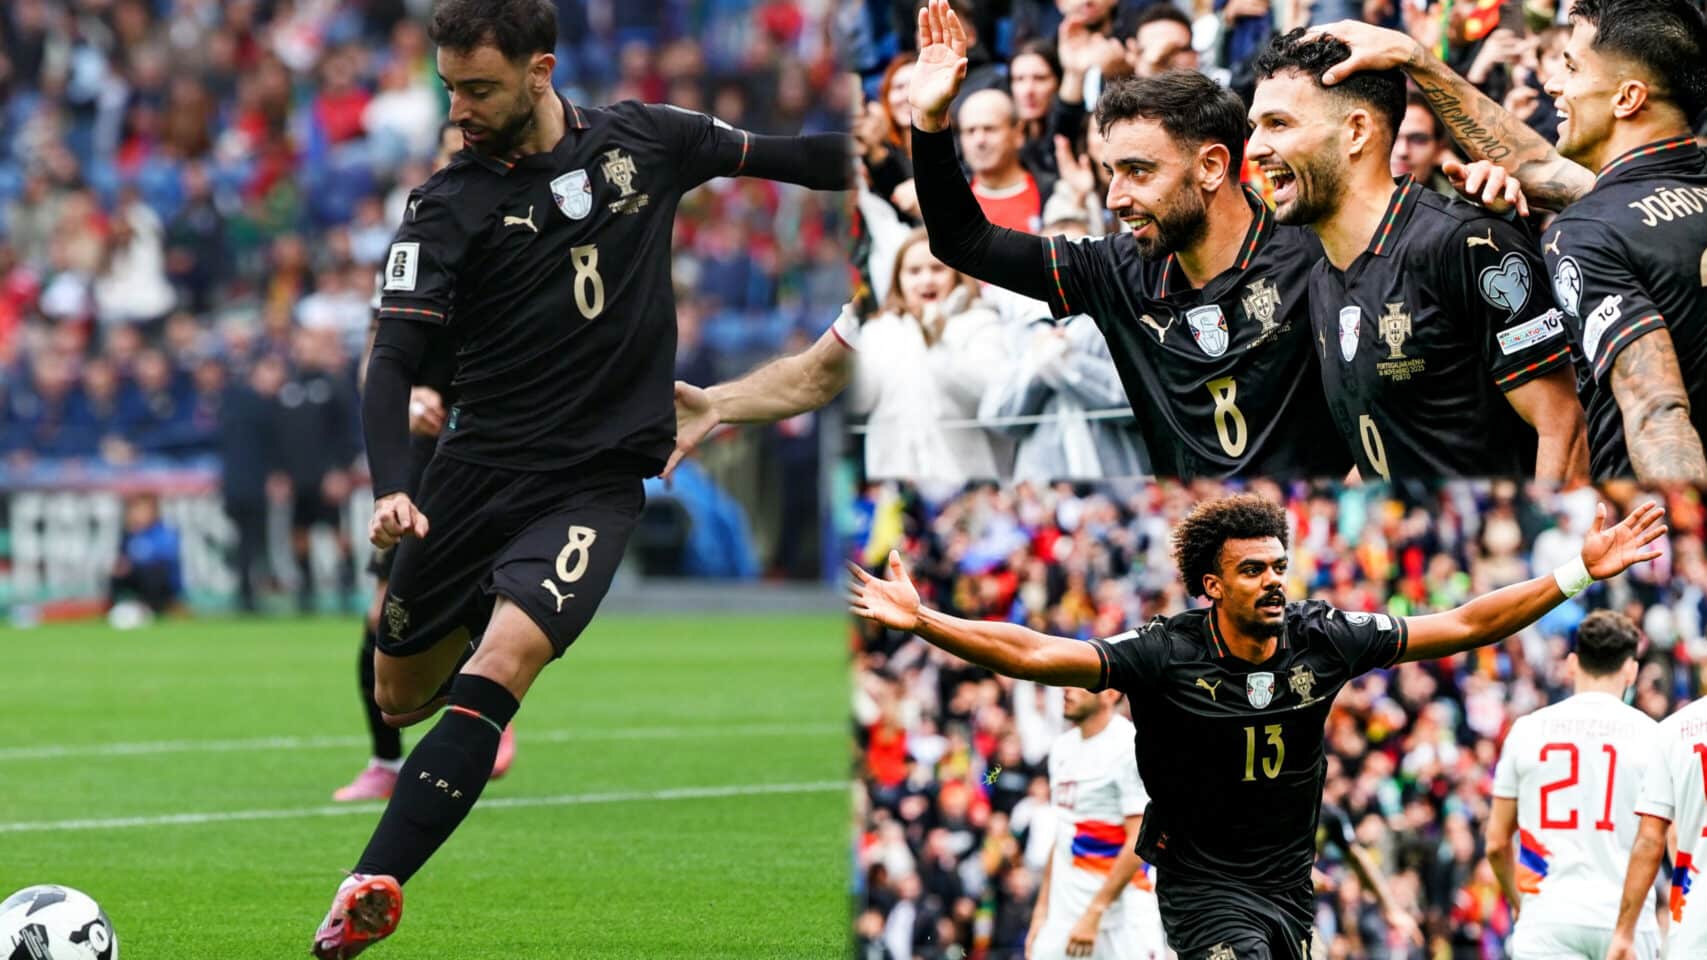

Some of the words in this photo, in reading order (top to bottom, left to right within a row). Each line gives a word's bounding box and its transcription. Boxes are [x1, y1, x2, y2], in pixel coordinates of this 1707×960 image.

[1627, 186, 1704, 227] JOÃO
[570, 243, 605, 320] 8
[1207, 375, 1248, 458] 8
[555, 525, 598, 583] 8
[1241, 724, 1286, 781] 13
[1539, 742, 1617, 831] 21
